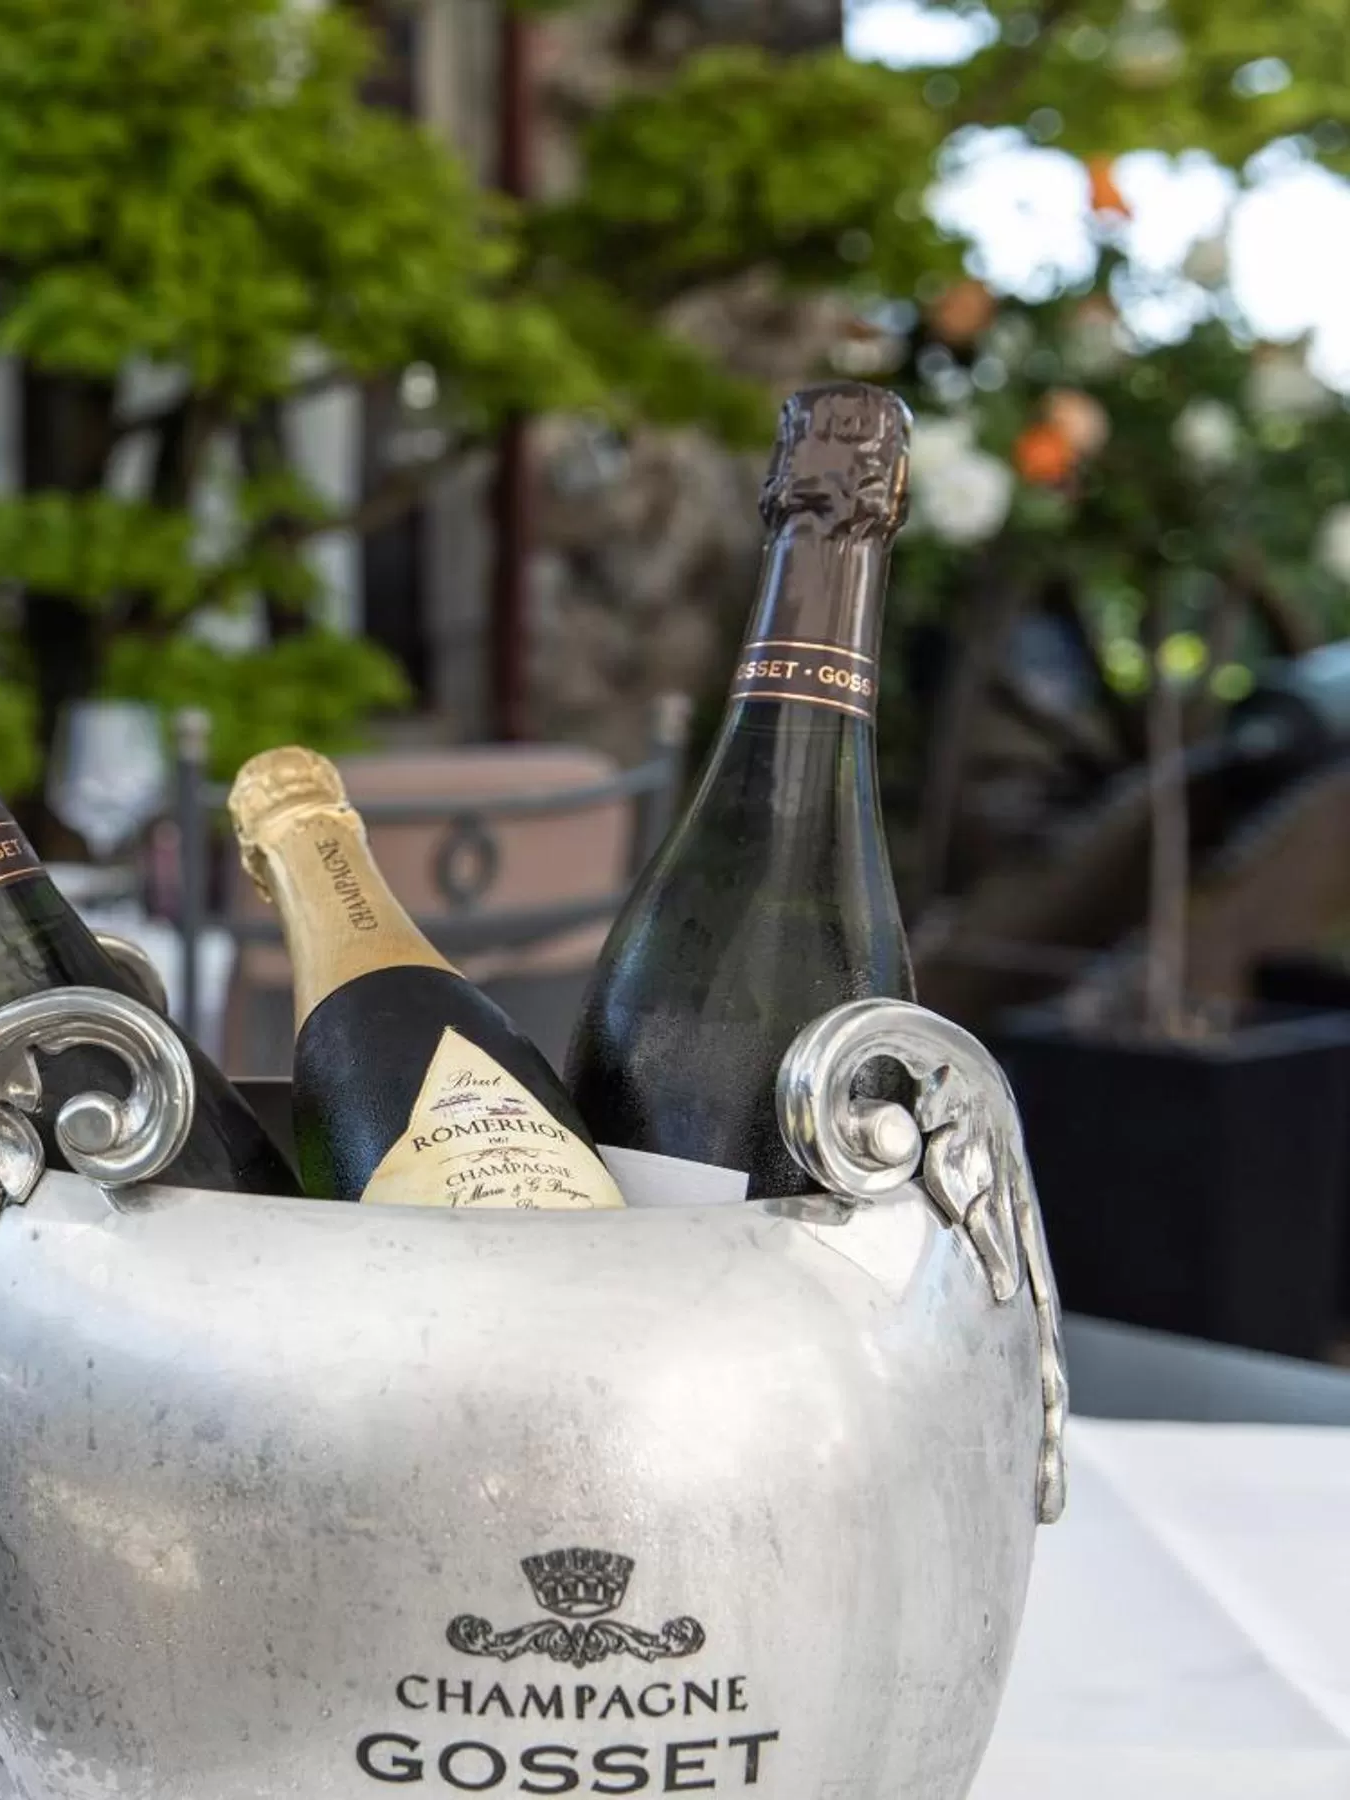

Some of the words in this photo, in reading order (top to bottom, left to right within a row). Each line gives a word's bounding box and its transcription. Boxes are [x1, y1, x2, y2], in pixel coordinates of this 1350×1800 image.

[315, 838, 379, 932] CHAMPAGNE
[441, 1068, 502, 1092] Brut
[446, 1161, 575, 1188] CHAMPAGNE
[395, 1673, 749, 1720] CHAMPAGNE
[355, 1730, 780, 1795] GOSSET
